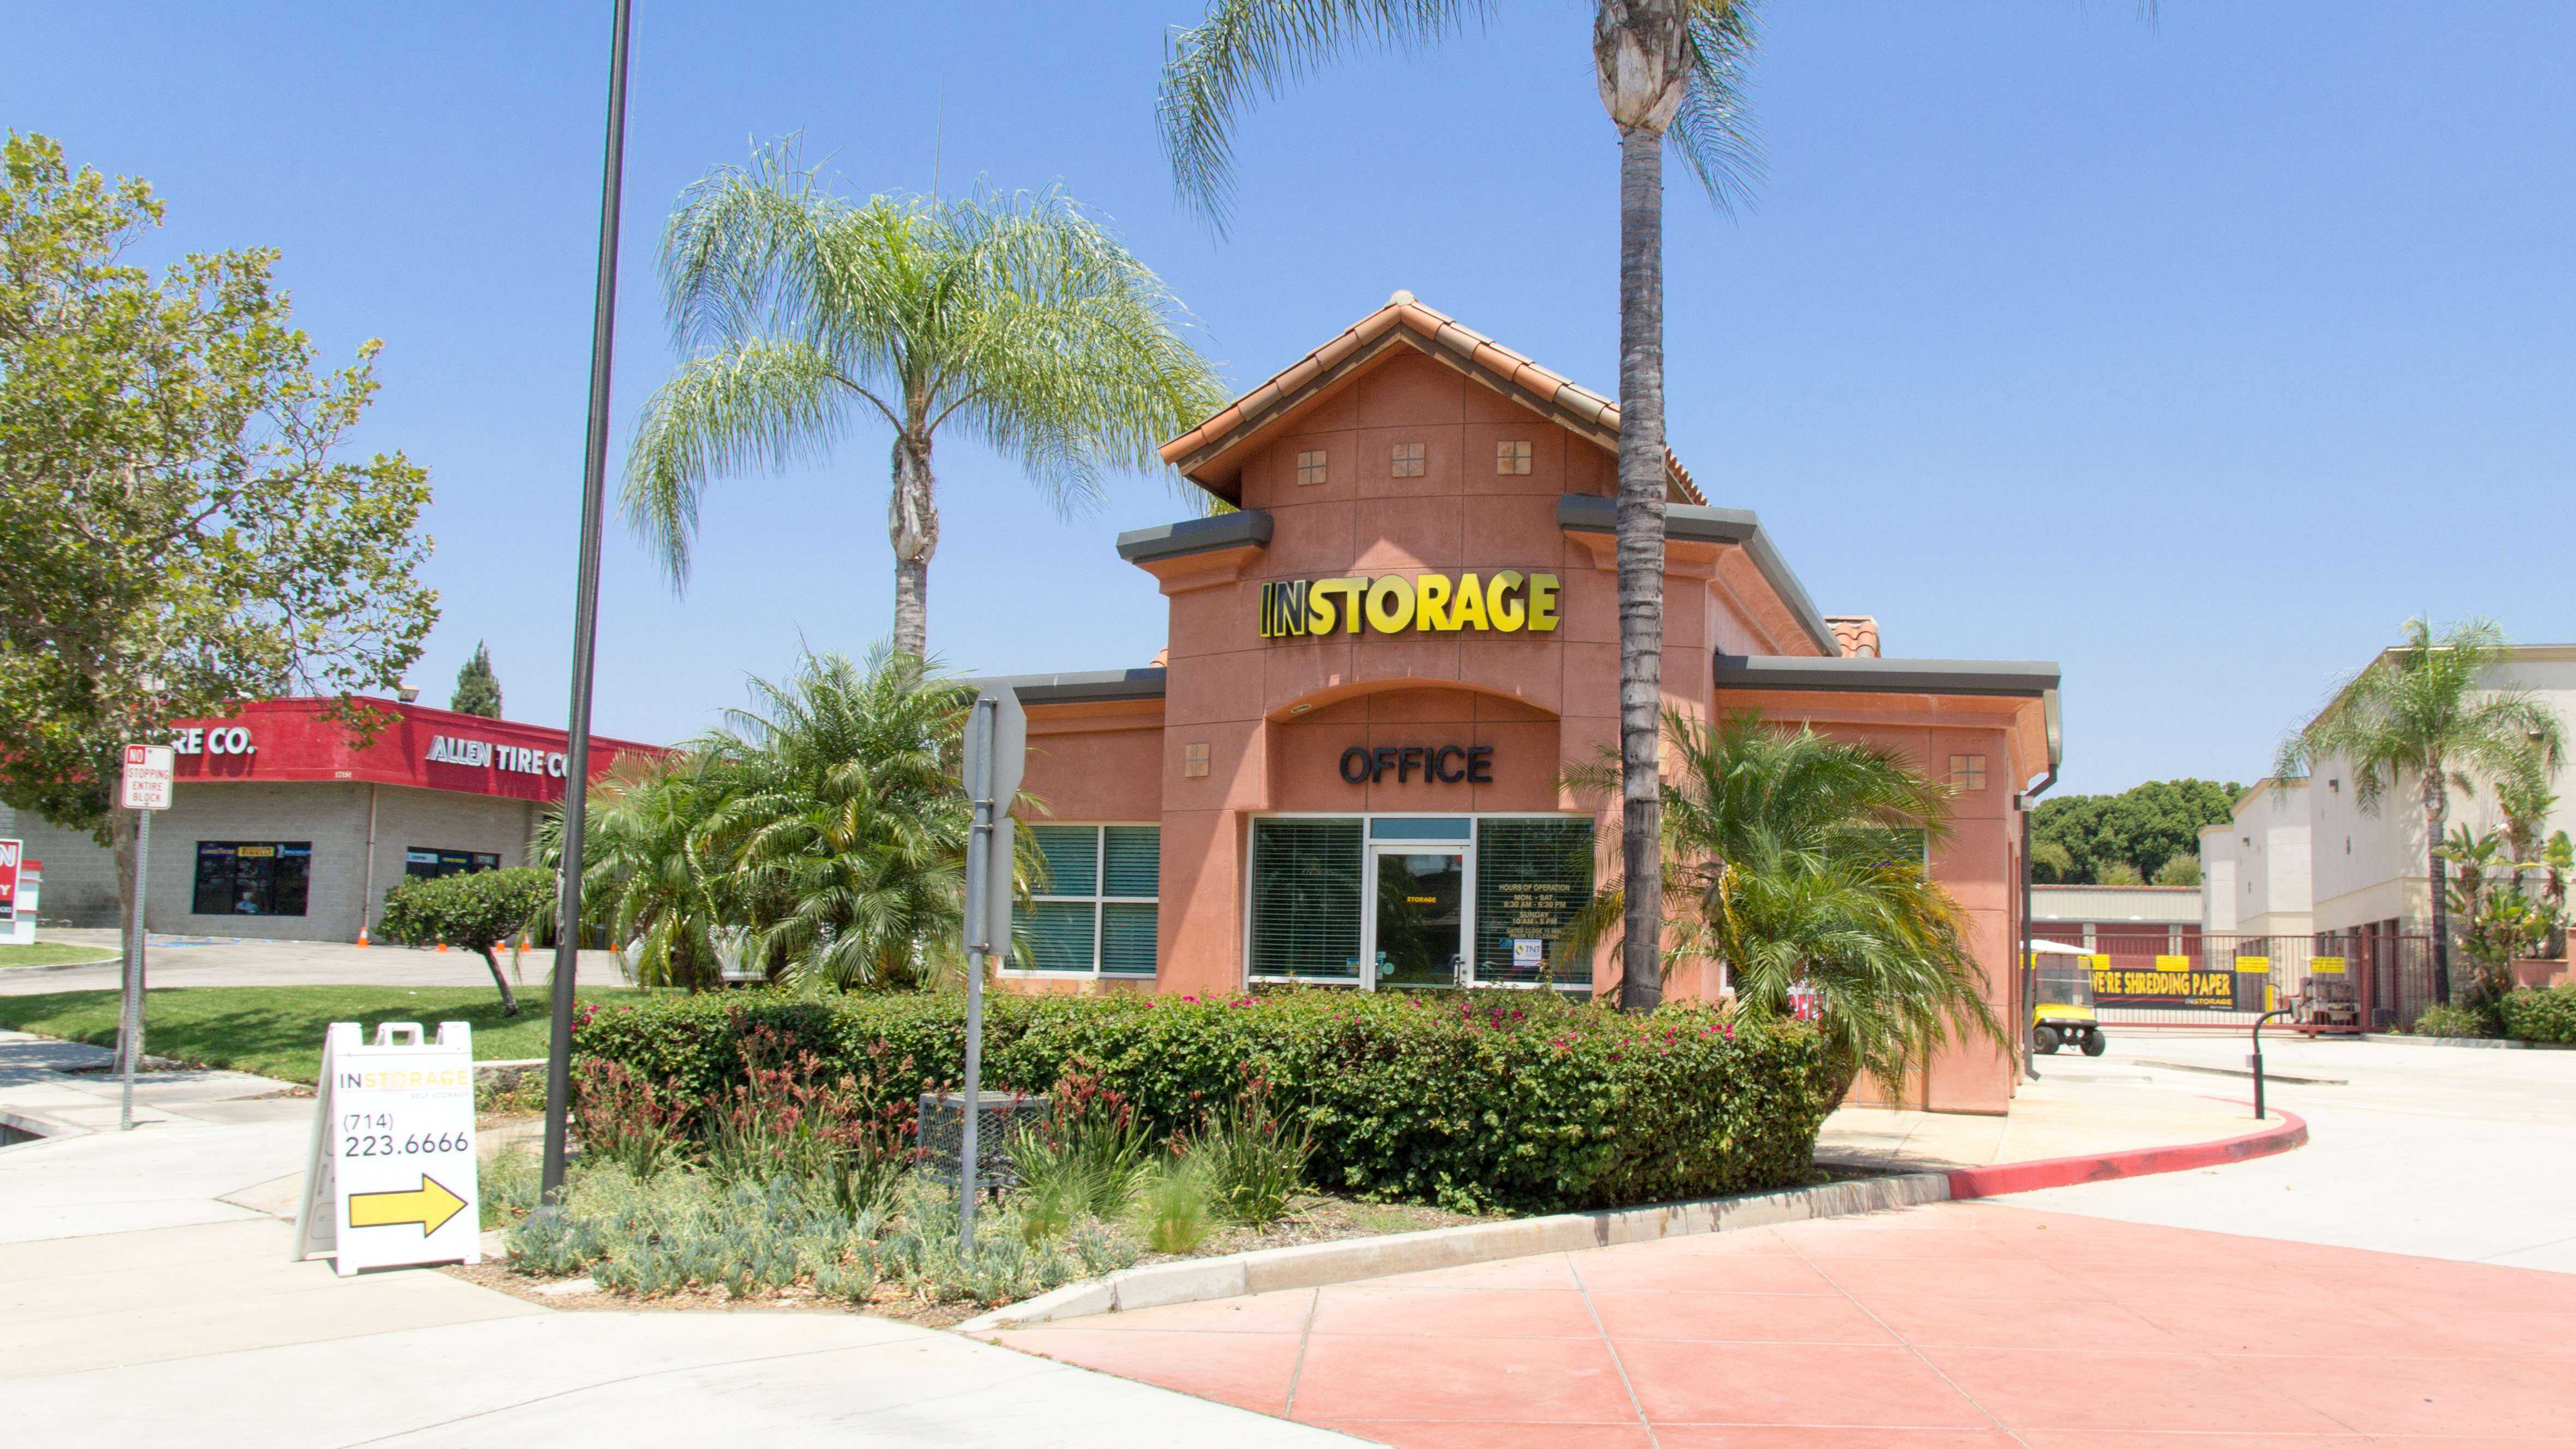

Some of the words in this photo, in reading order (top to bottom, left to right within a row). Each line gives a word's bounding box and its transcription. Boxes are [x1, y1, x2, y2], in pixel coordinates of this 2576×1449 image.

[1260, 570, 1561, 638] INSTORAGE
[208, 727, 256, 754] CO.
[128, 748, 145, 763] NO
[426, 735, 492, 767] ALLEN
[496, 744, 545, 774] TIRE
[1339, 745, 1493, 784] OFFICE
[127, 768, 169, 779] STOPPING
[133, 782, 163, 791] ENTIRE
[133, 793, 161, 802] BLOCK
[2124, 972, 2190, 996] SHREDDING
[2192, 973, 2231, 996] PAPER
[340, 1069, 469, 1089] INSTORAGE
[344, 1113, 393, 1133] (714)
[345, 1132, 468, 1157] 223.6666
